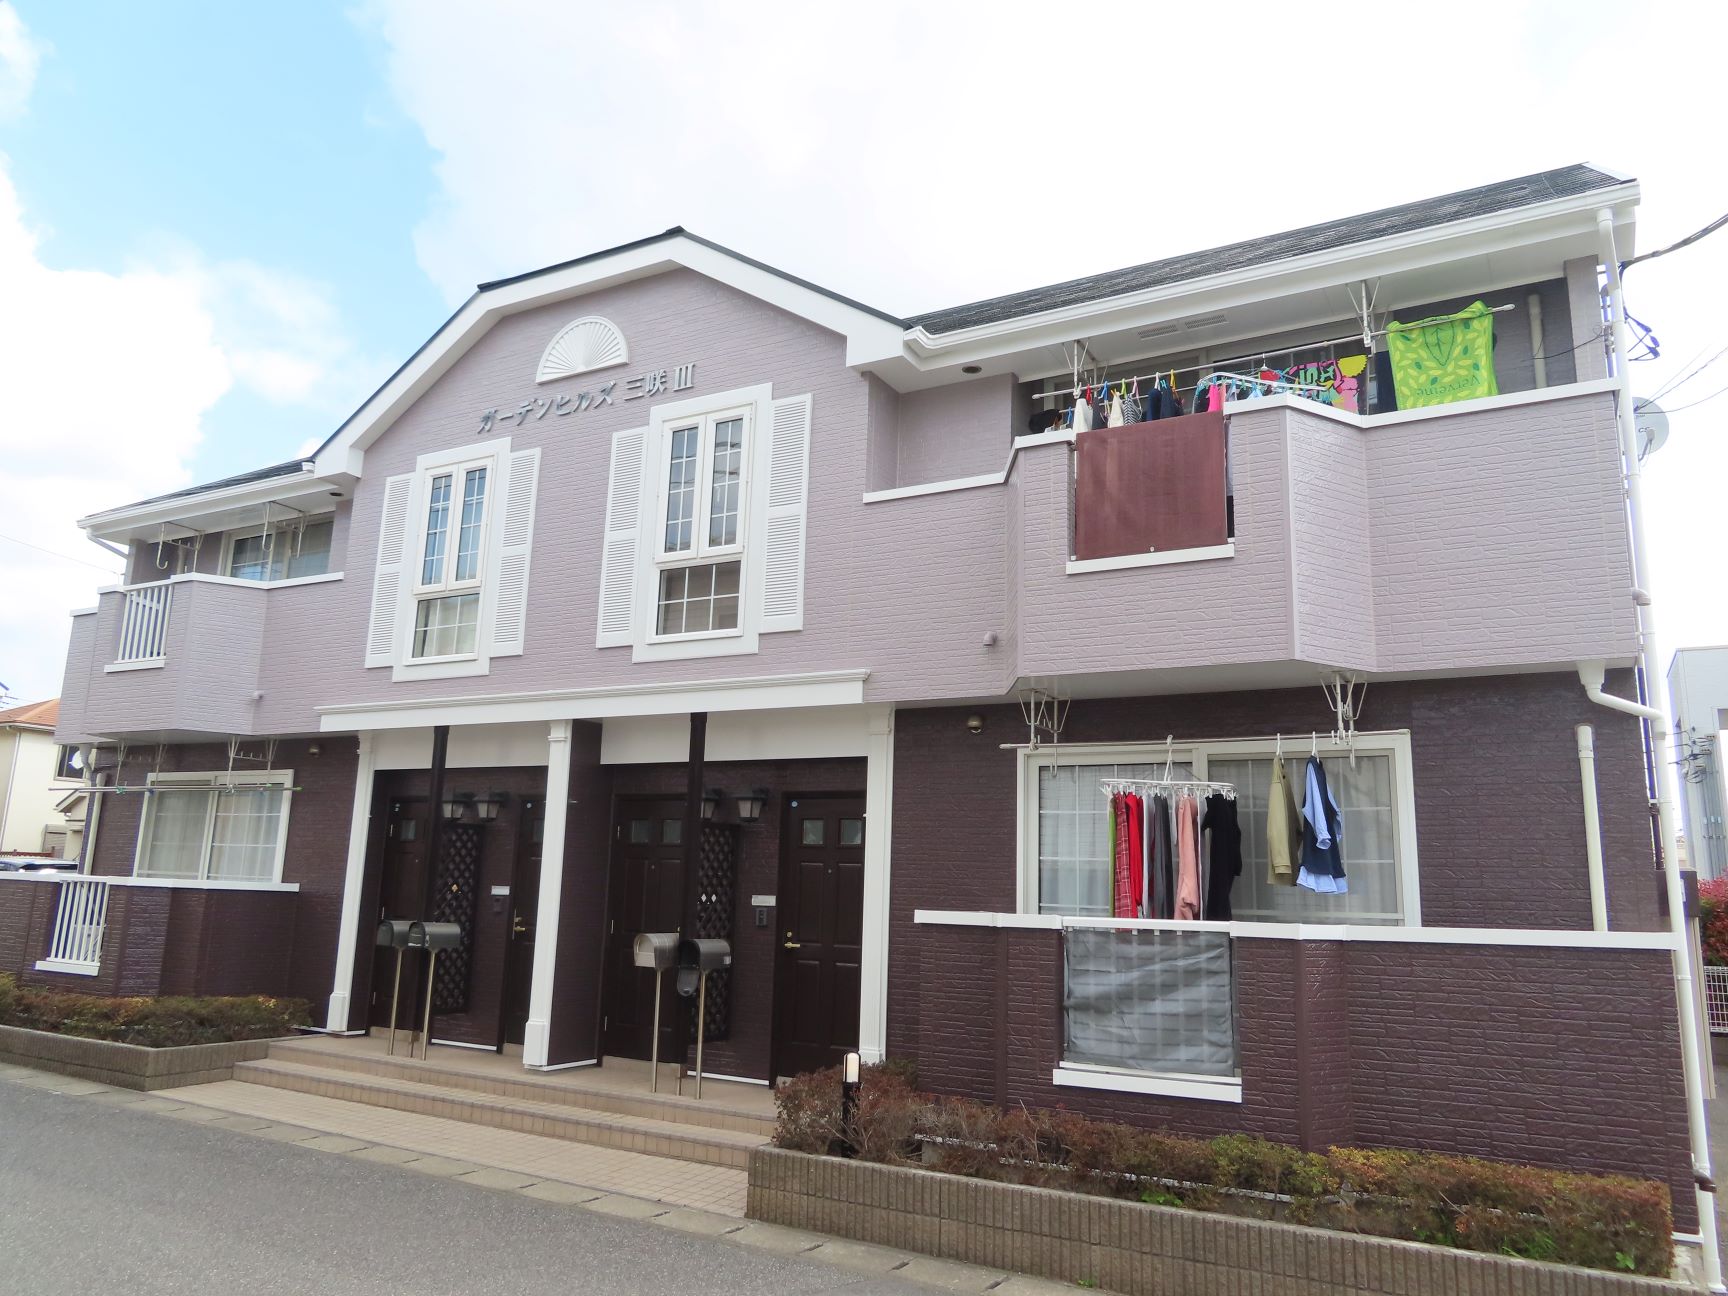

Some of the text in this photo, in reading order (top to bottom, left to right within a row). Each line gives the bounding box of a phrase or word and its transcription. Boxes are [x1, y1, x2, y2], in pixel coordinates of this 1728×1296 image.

[477, 380, 616, 434] ガーデンヒルズ
[623, 369, 667, 402] 三咲
